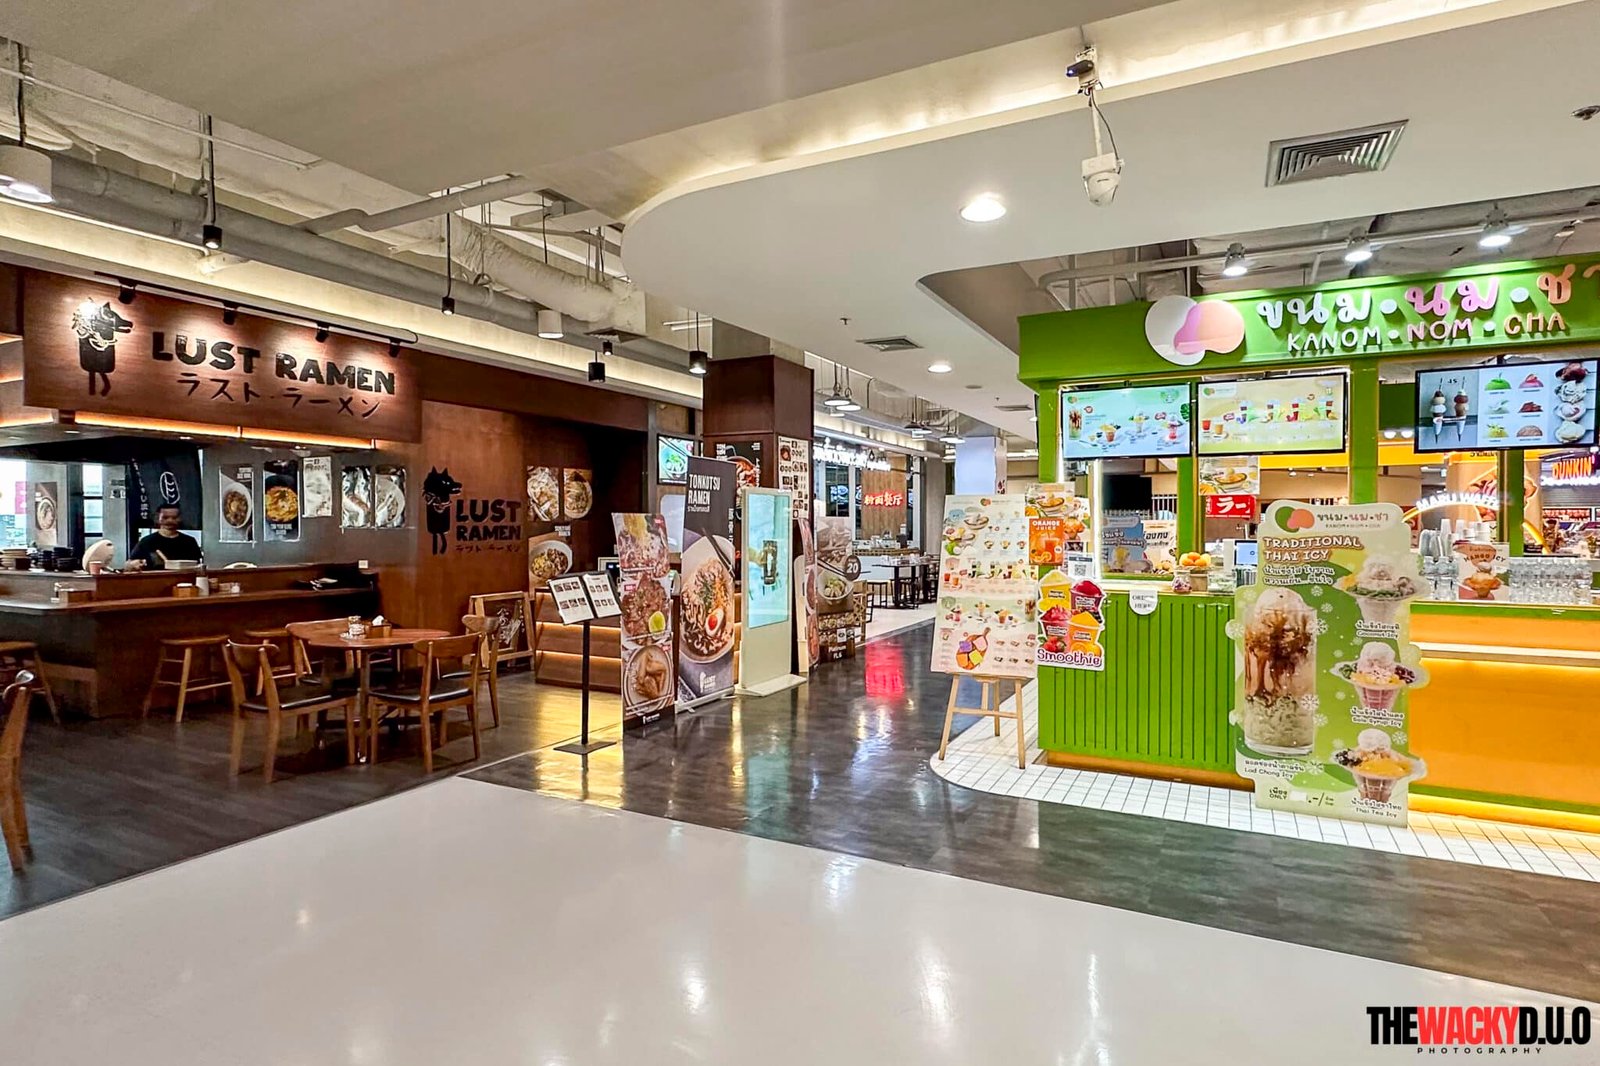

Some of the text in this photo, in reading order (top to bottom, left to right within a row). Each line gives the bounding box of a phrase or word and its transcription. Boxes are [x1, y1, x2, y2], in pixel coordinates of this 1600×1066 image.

[1256, 289, 1371, 329] ขนม
[1405, 276, 1499, 316] นม
[1288, 312, 1566, 351] KANOM NOM CHA
[152, 332, 396, 395] LUST RAMEN
[1553, 454, 1595, 480] DUNKIN'
[688, 490, 710, 505] RAMEN
[456, 499, 521, 522] LUST
[456, 525, 521, 541] RAMEN
[1263, 536, 1362, 549] TRADITIONAL
[1264, 549, 1329, 561] THAI ICY
[846, 563, 859, 574] 20
[1037, 649, 1102, 667] Smoothie
